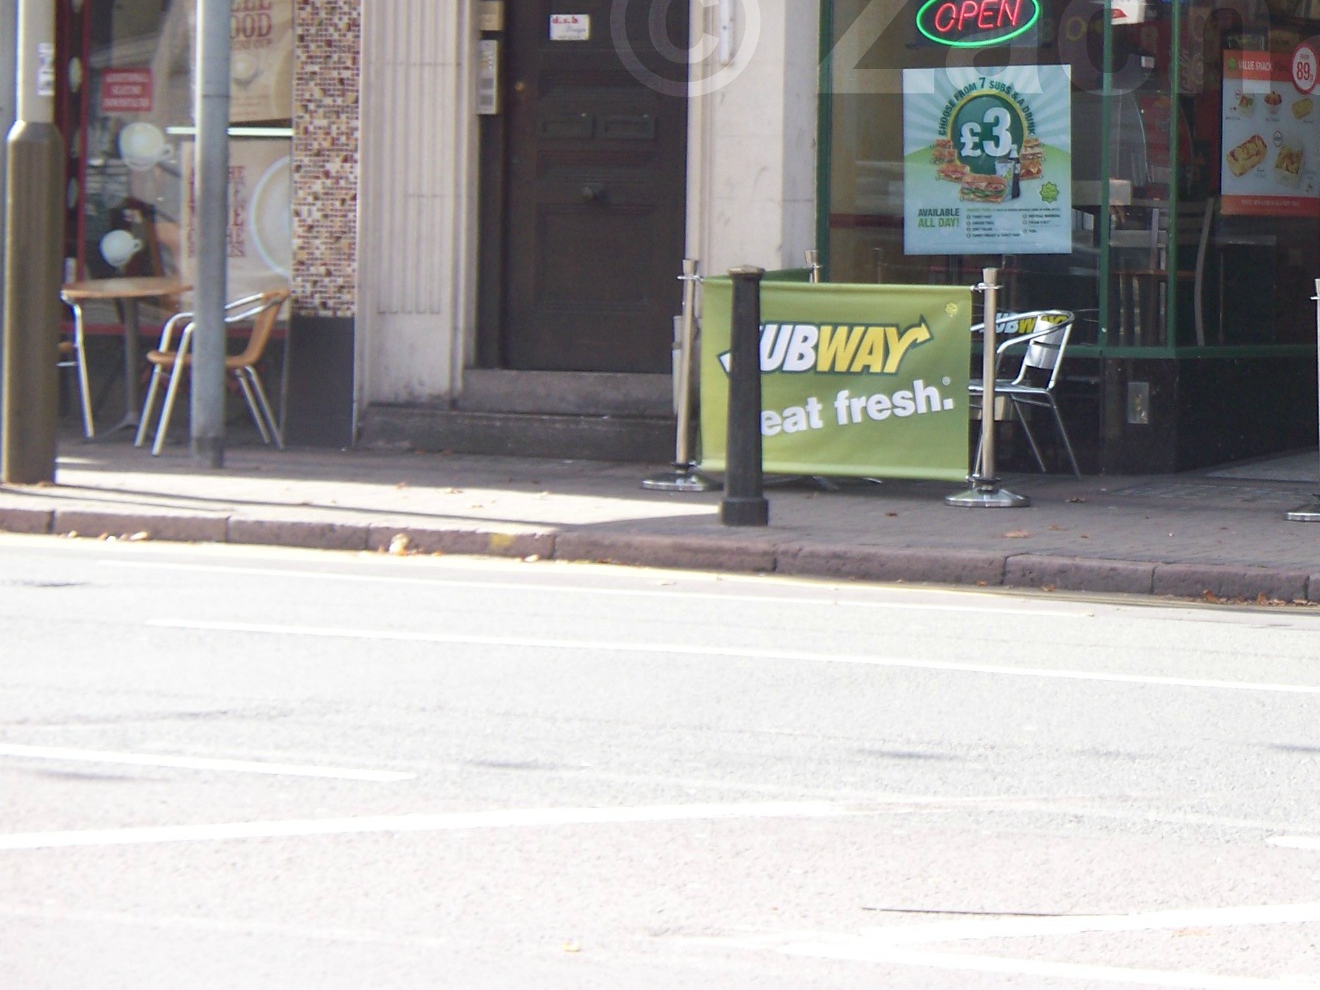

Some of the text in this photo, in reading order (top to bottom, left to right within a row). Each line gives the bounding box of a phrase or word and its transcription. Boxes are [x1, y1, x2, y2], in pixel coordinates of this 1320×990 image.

[230, 12, 272, 38] OOD
[938, 77, 1036, 136] CHOOSE FROM 7 SUBS & A DRINK
[960, 107, 1013, 158] £3
[918, 207, 960, 217] AVAILABLE
[918, 218, 934, 228] ALL
[938, 217, 960, 228] DAY!
[718, 320, 932, 374] UBWAY
[761, 379, 955, 437] eat fresh.
